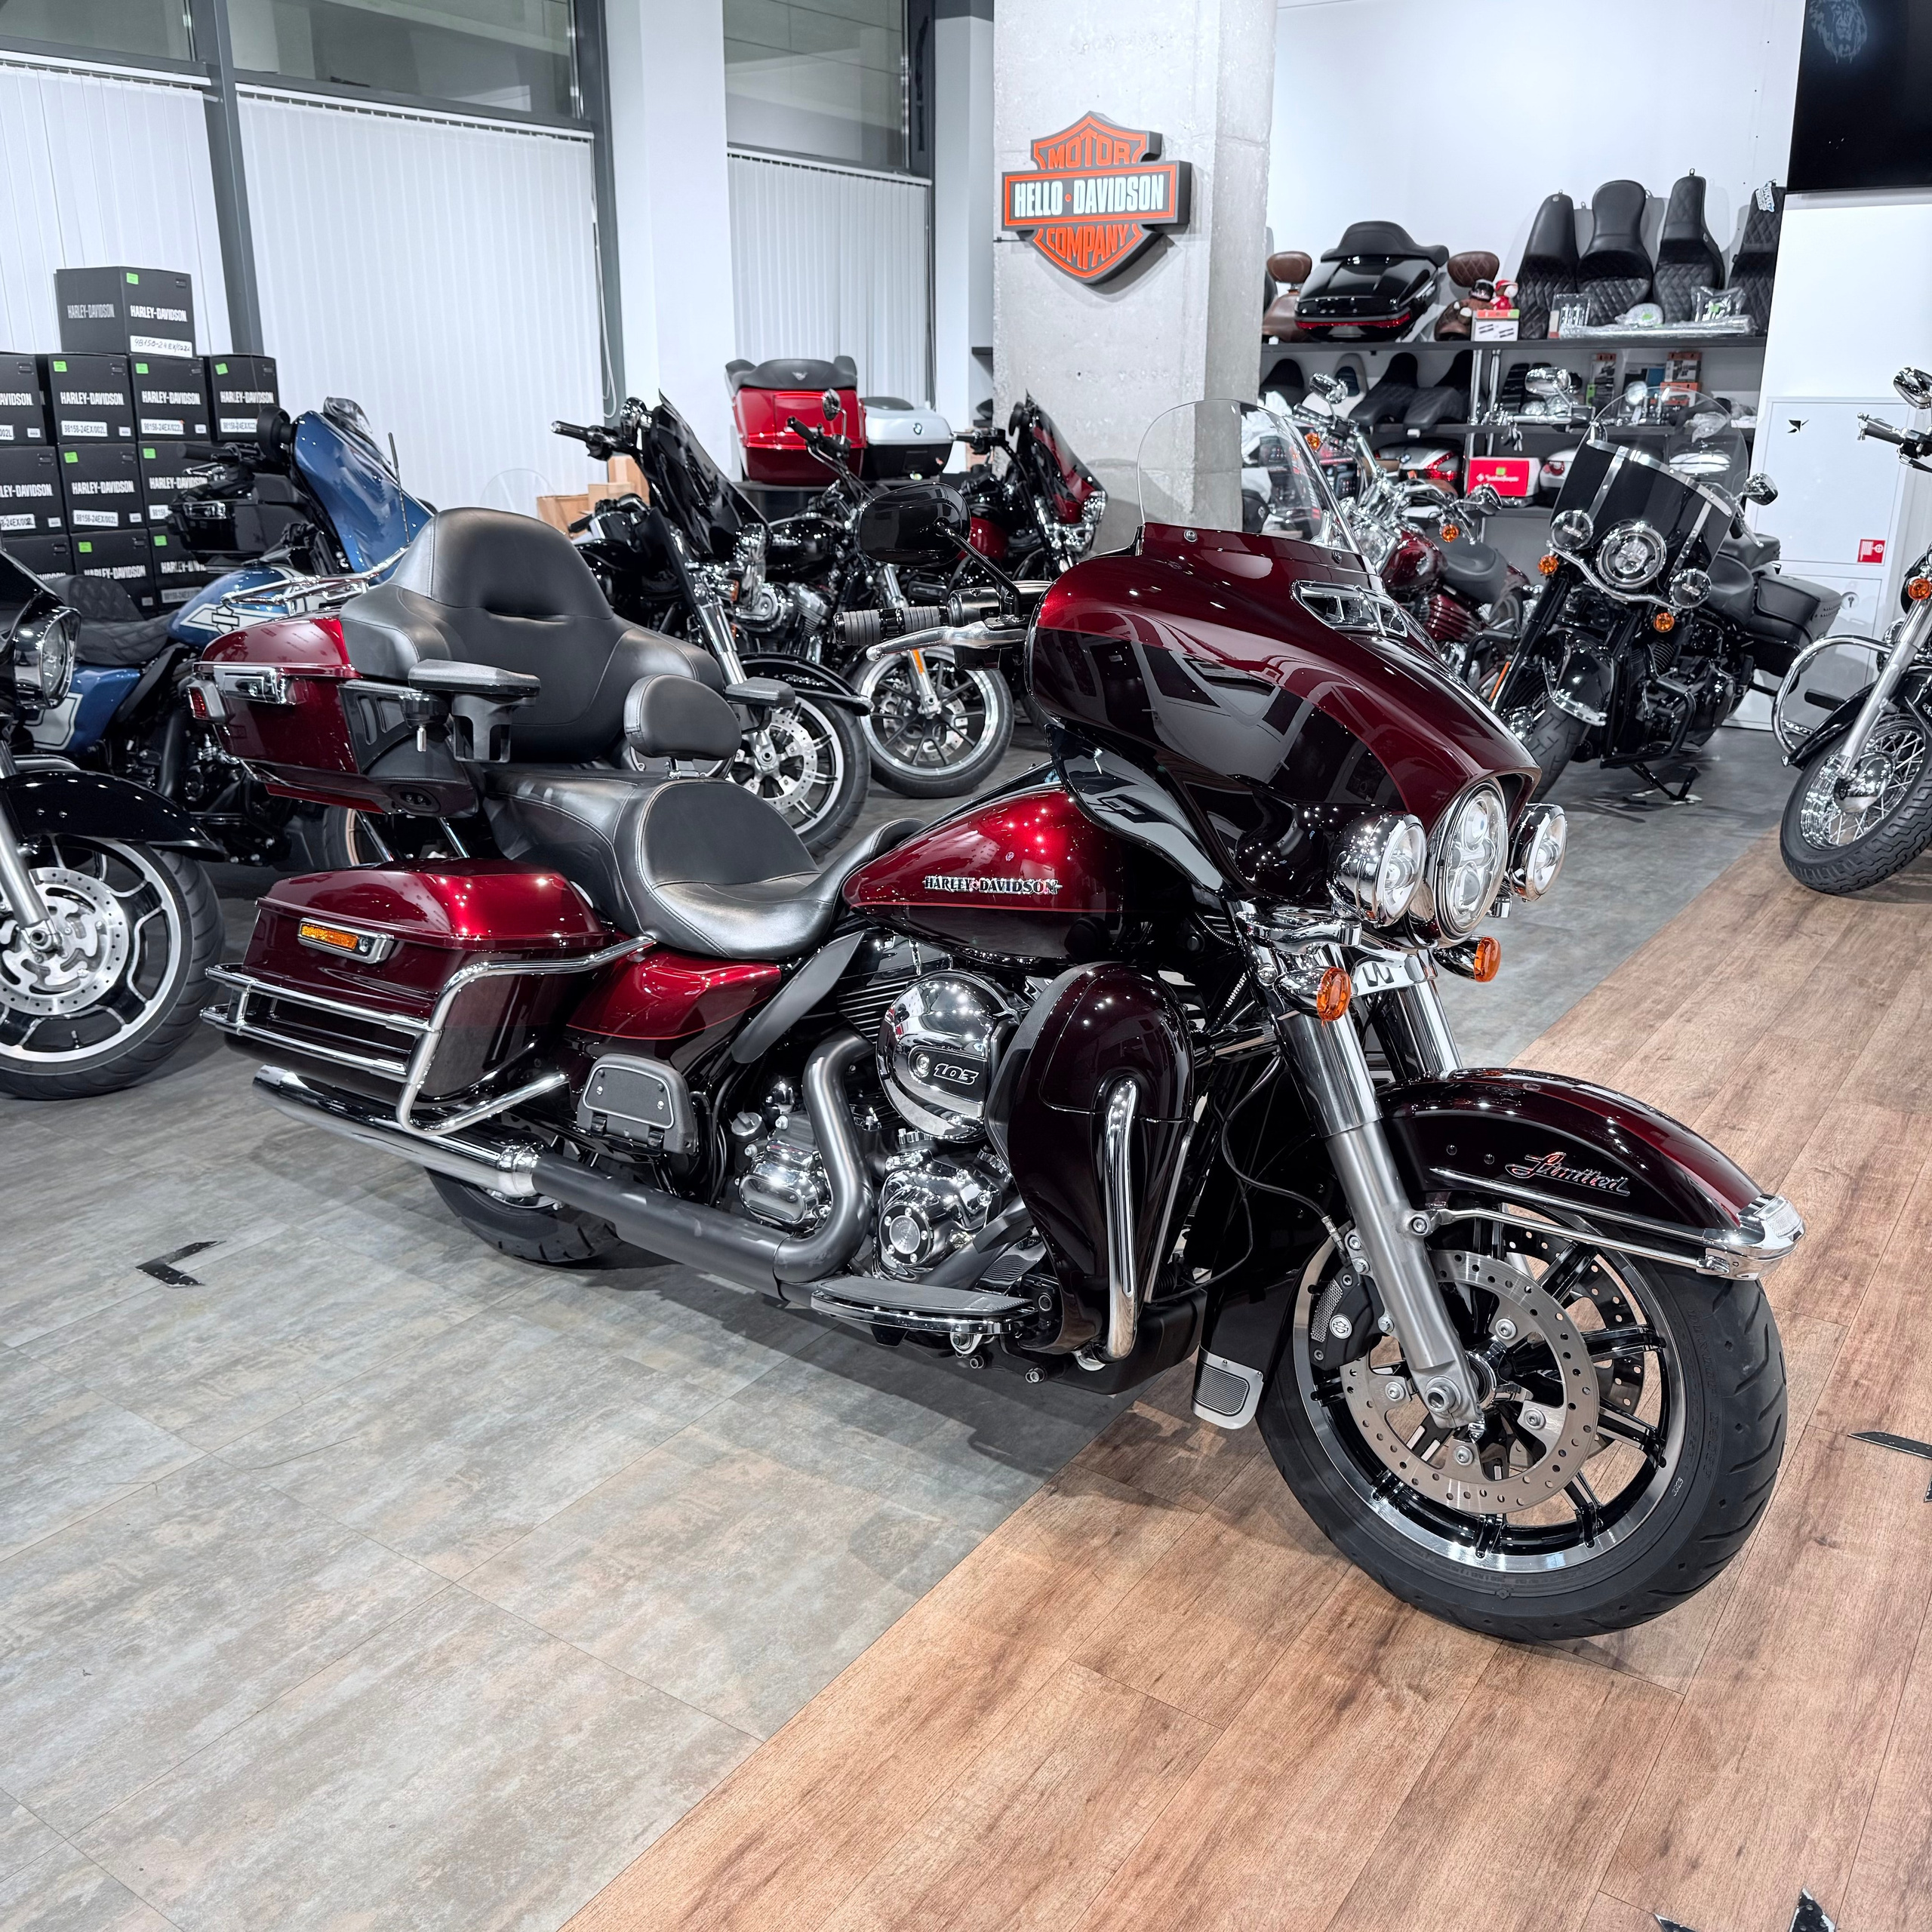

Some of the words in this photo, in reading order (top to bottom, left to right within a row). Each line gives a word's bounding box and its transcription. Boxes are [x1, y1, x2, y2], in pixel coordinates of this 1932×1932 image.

[1048, 127, 1131, 170] MOTOR
[1014, 181, 1063, 217] HELLO
[1073, 174, 1164, 214] DAVIDSON
[1046, 223, 1130, 269] COMPANY
[67, 303, 115, 319] HARLEY-DAVIDSON
[130, 305, 188, 322] HARLEY-DAVIDSON
[60, 391, 125, 406] HARLEY-DAVIDSON
[141, 390, 202, 405] HARLEY-DAVIDSON
[220, 390, 275, 405] HARLEY-DAVIDSON
[71, 480, 136, 495] HARLEY-DAVIDSON
[934, 1063, 980, 1085] 103
[1505, 1152, 1631, 1197] Limited
